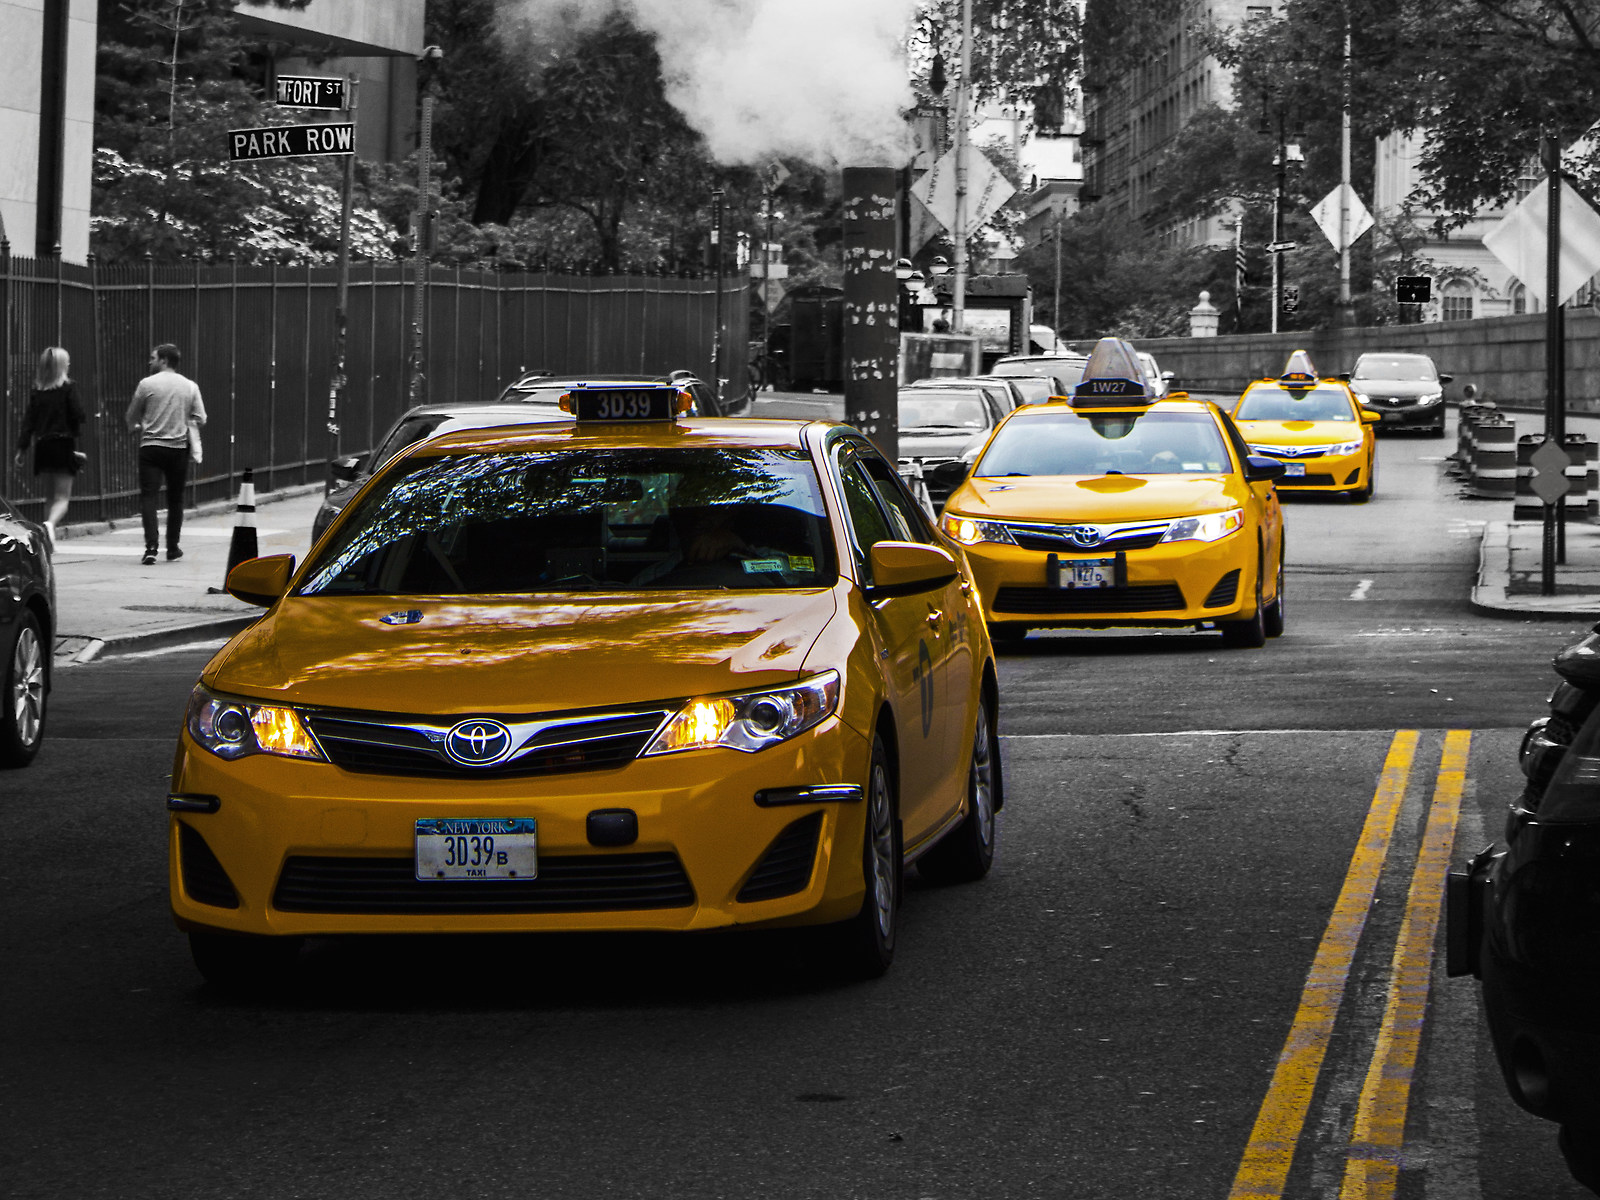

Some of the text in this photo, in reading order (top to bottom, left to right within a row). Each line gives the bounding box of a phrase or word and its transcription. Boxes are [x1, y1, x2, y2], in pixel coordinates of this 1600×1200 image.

[325, 82, 341, 94] ST
[234, 127, 351, 157] PARK ROW
[1092, 382, 1127, 393] 1W27
[597, 391, 651, 419] 3D39
[445, 821, 507, 834] NEW YORK
[466, 869, 487, 877] TAXI
